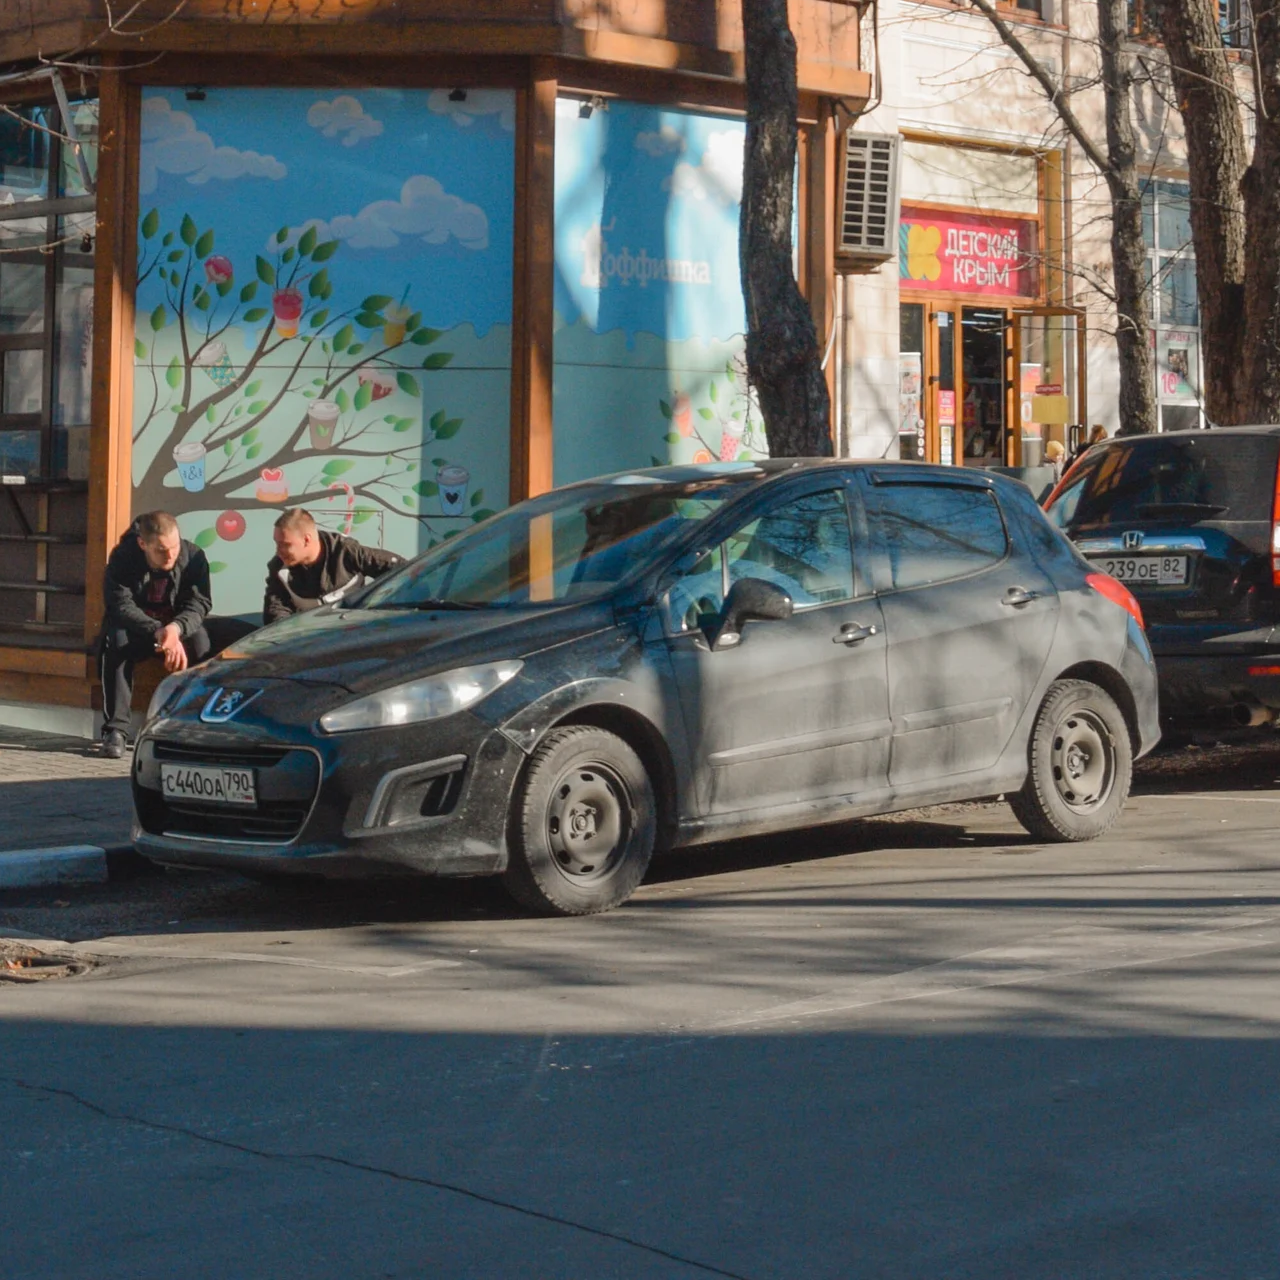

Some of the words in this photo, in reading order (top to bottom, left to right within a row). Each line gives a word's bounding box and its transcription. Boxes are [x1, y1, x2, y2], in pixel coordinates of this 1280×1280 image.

[945, 228, 1018, 260] ДЕТСКИЙ
[953, 258, 1010, 288] КРЫМ
[1104, 560, 1158, 578] 239ОЕ
[1163, 558, 1180, 572] 82
[166, 770, 224, 797] С440ОА
[225, 772, 250, 791] 790
